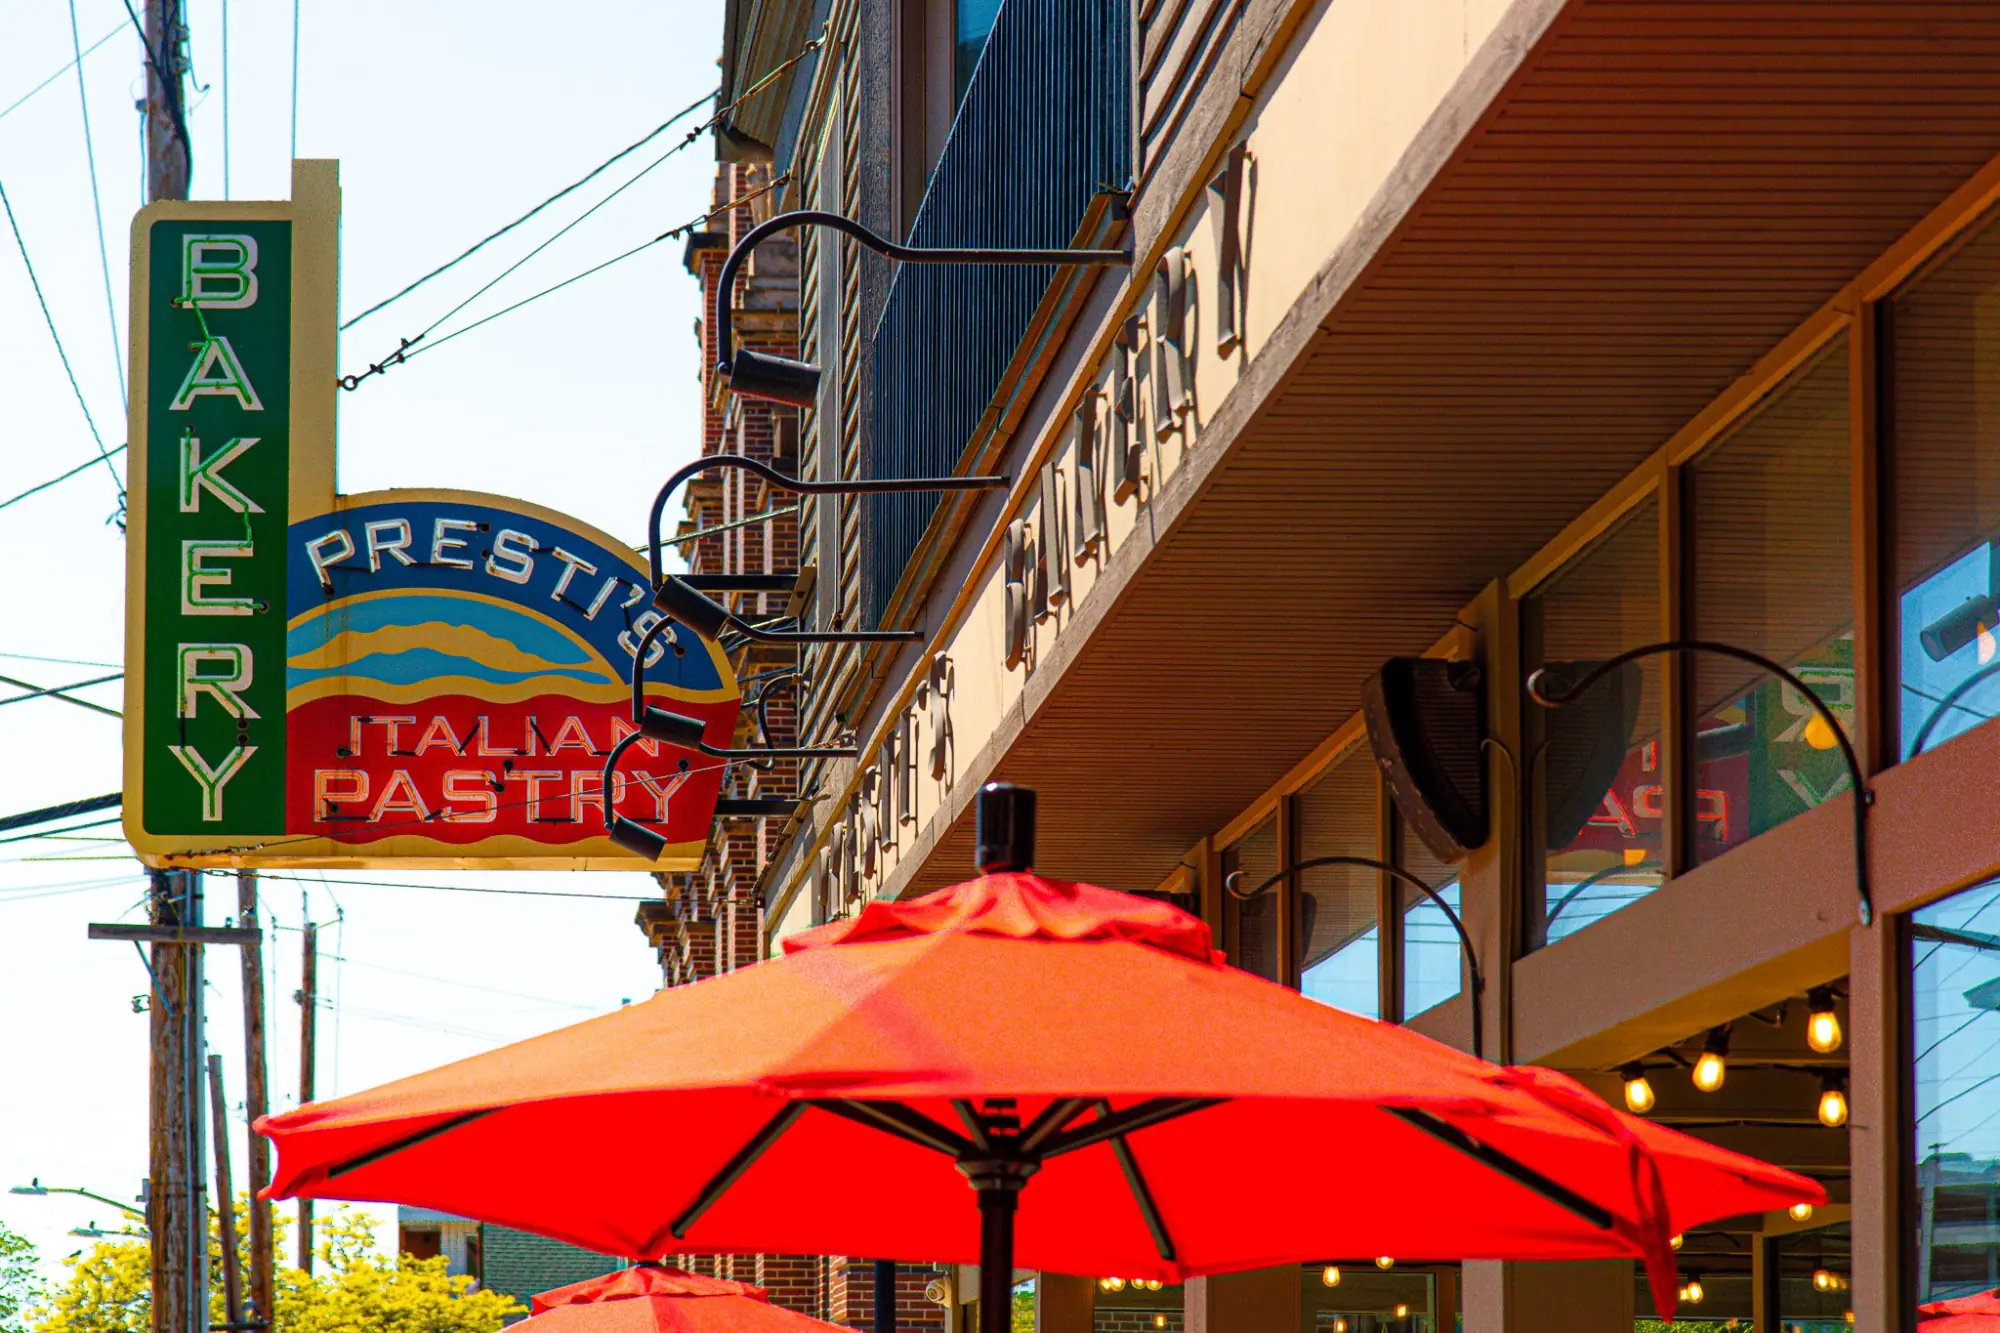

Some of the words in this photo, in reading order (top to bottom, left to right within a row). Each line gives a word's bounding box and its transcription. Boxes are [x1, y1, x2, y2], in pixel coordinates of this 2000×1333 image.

[1004, 139, 1249, 671] BAKERY
[167, 233, 266, 822] BAKERY
[305, 517, 678, 669] PRESTI'S
[313, 768, 692, 825] PASTRY
[348, 714, 660, 758] ITALIAN
